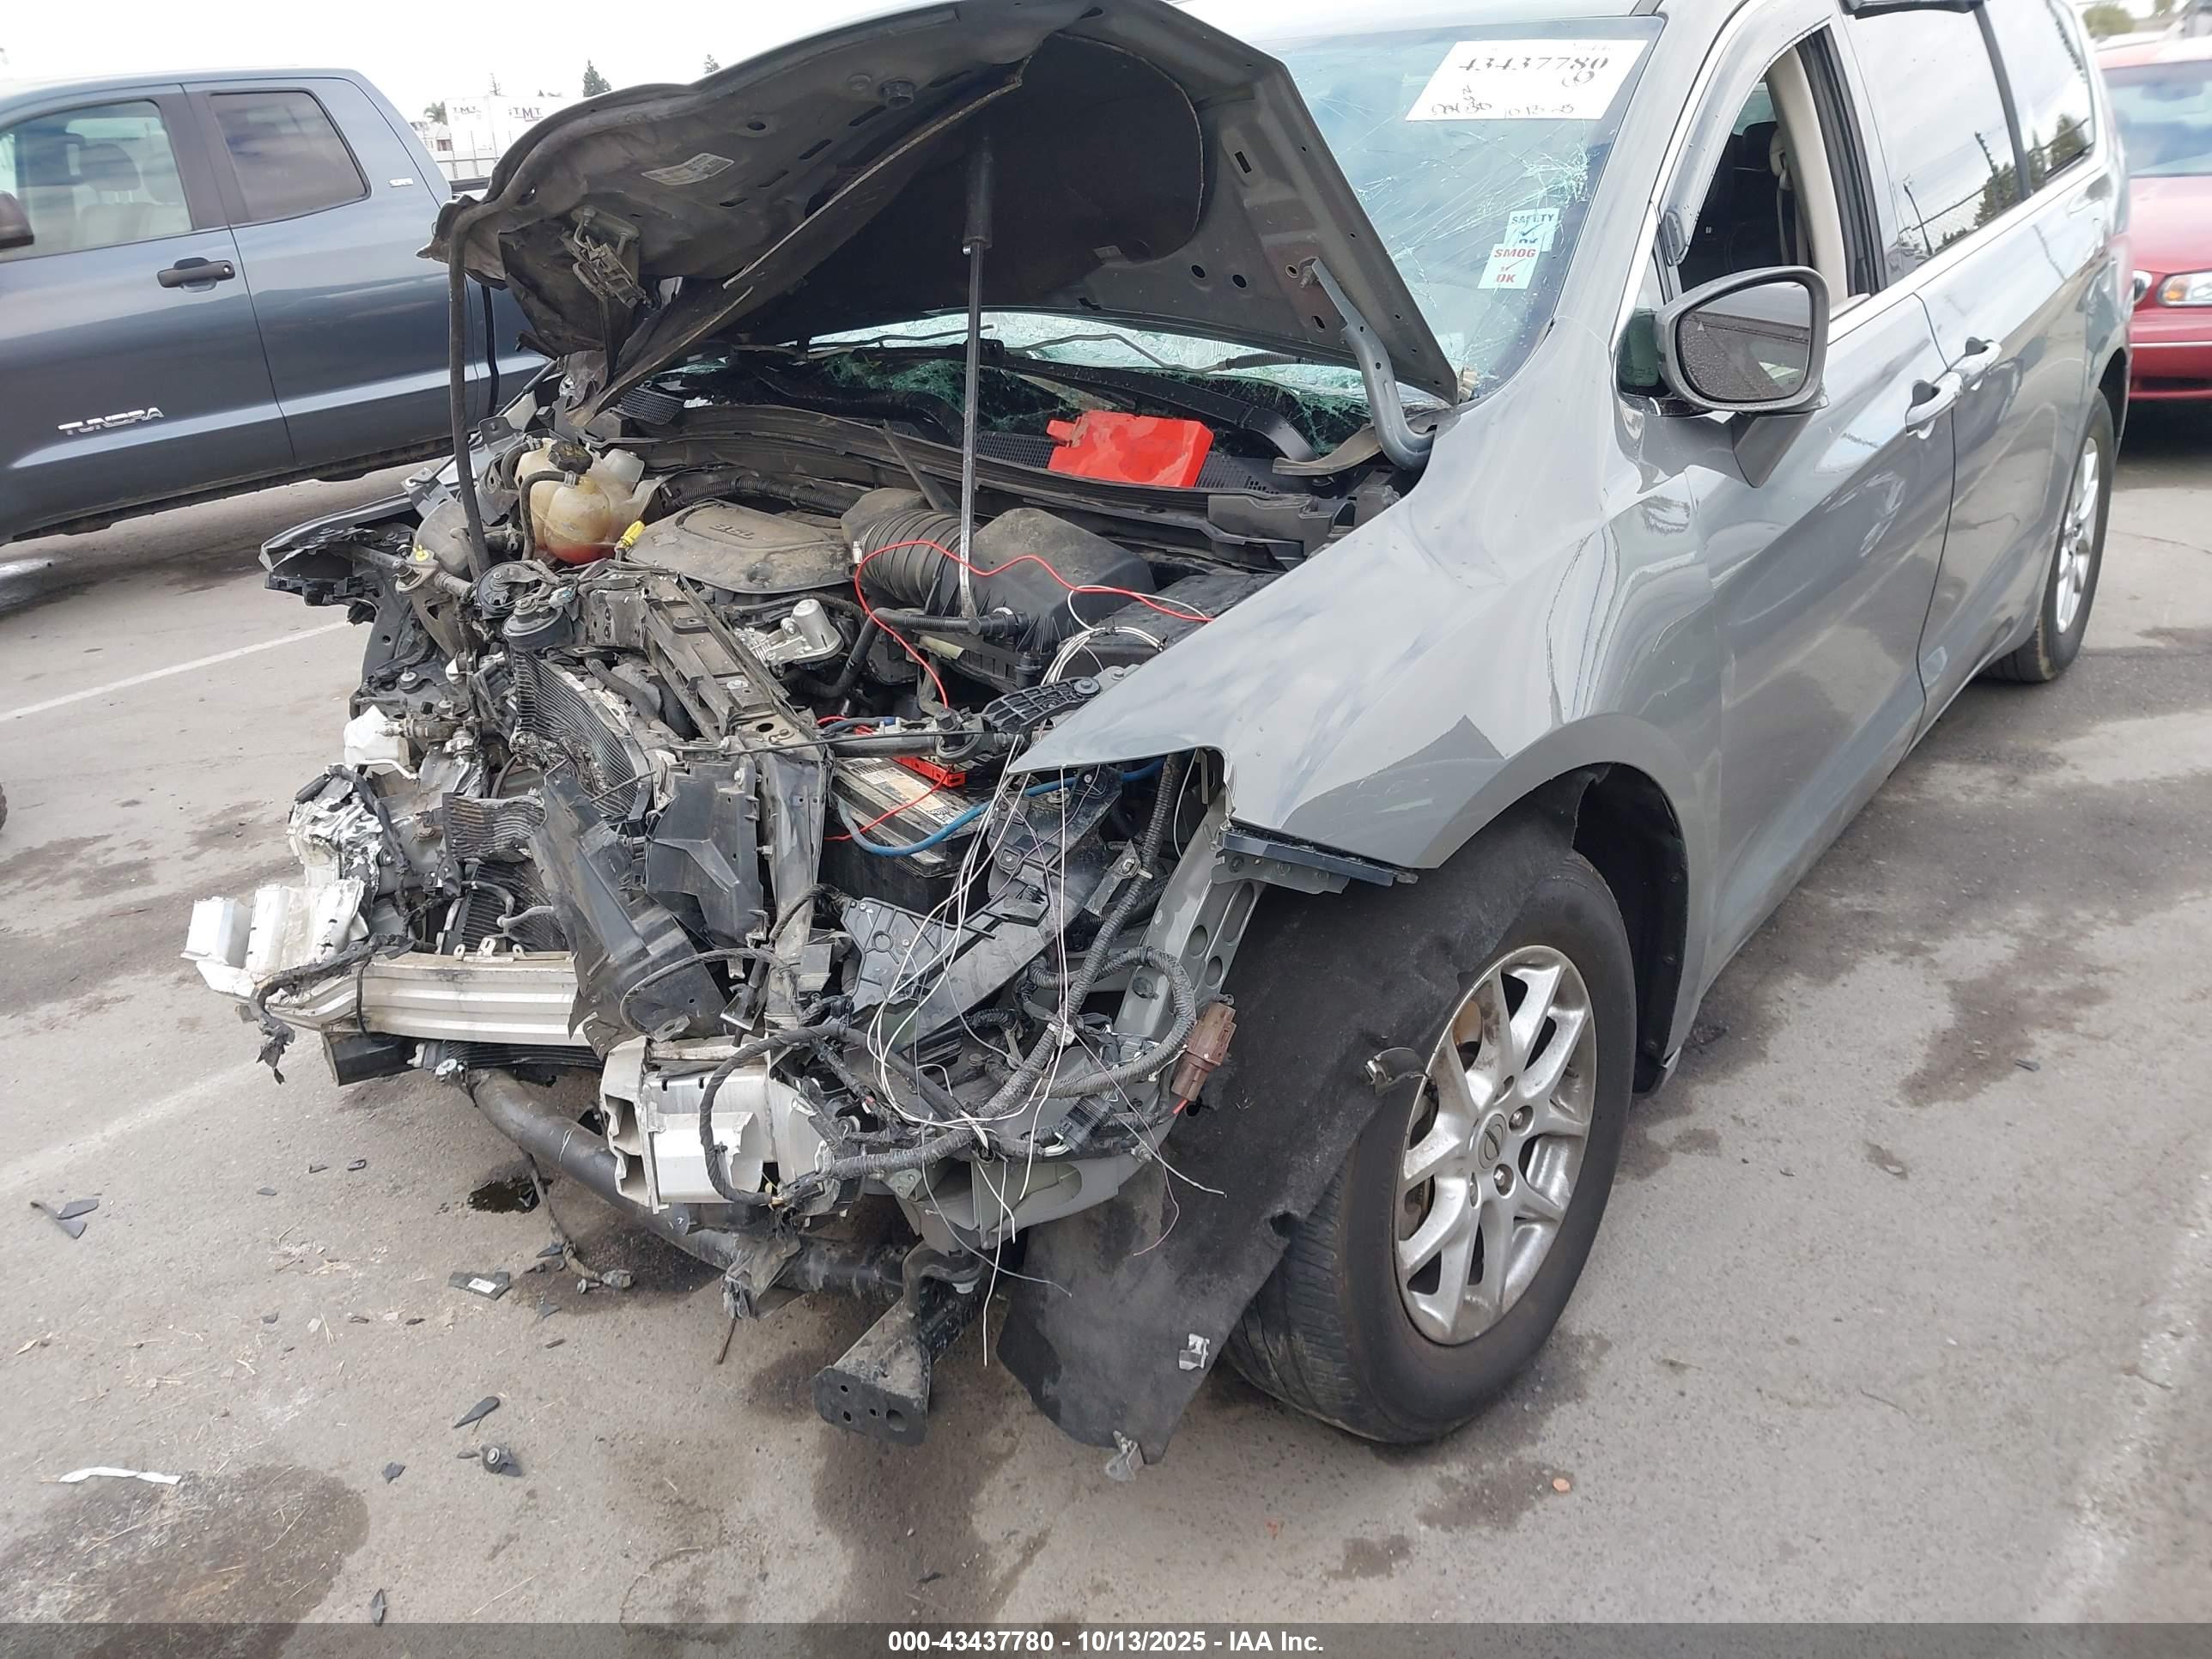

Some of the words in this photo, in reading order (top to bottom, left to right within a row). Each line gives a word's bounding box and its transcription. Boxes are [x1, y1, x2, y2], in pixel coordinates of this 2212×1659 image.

[1494, 248, 1536, 258] SMOG
[1497, 274, 1516, 283] OK
[58, 407, 165, 435] TUNDRA
